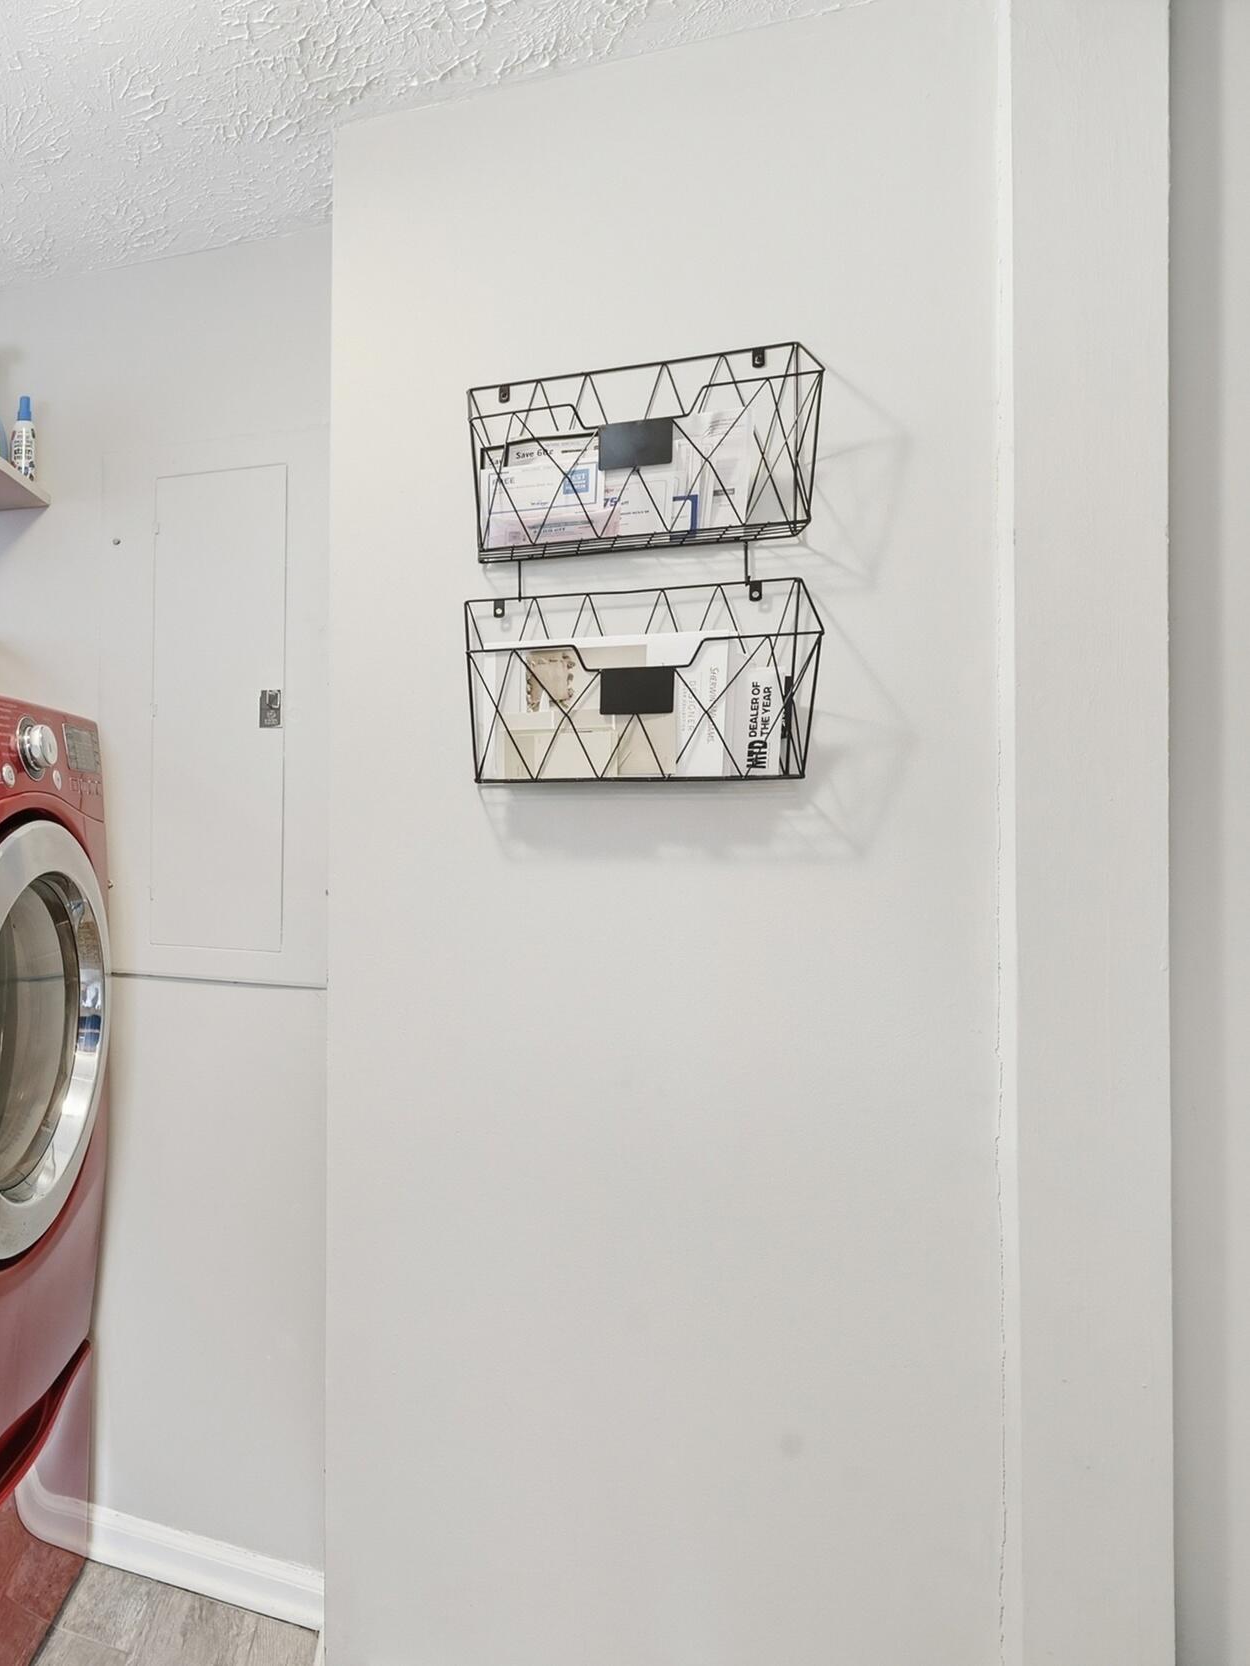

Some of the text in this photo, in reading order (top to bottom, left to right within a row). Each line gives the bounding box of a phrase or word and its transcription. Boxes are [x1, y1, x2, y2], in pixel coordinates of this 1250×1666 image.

[516, 451, 534, 460] Save
[748, 681, 761, 738] DEALER OF
[760, 686, 772, 738] THE YEAR
